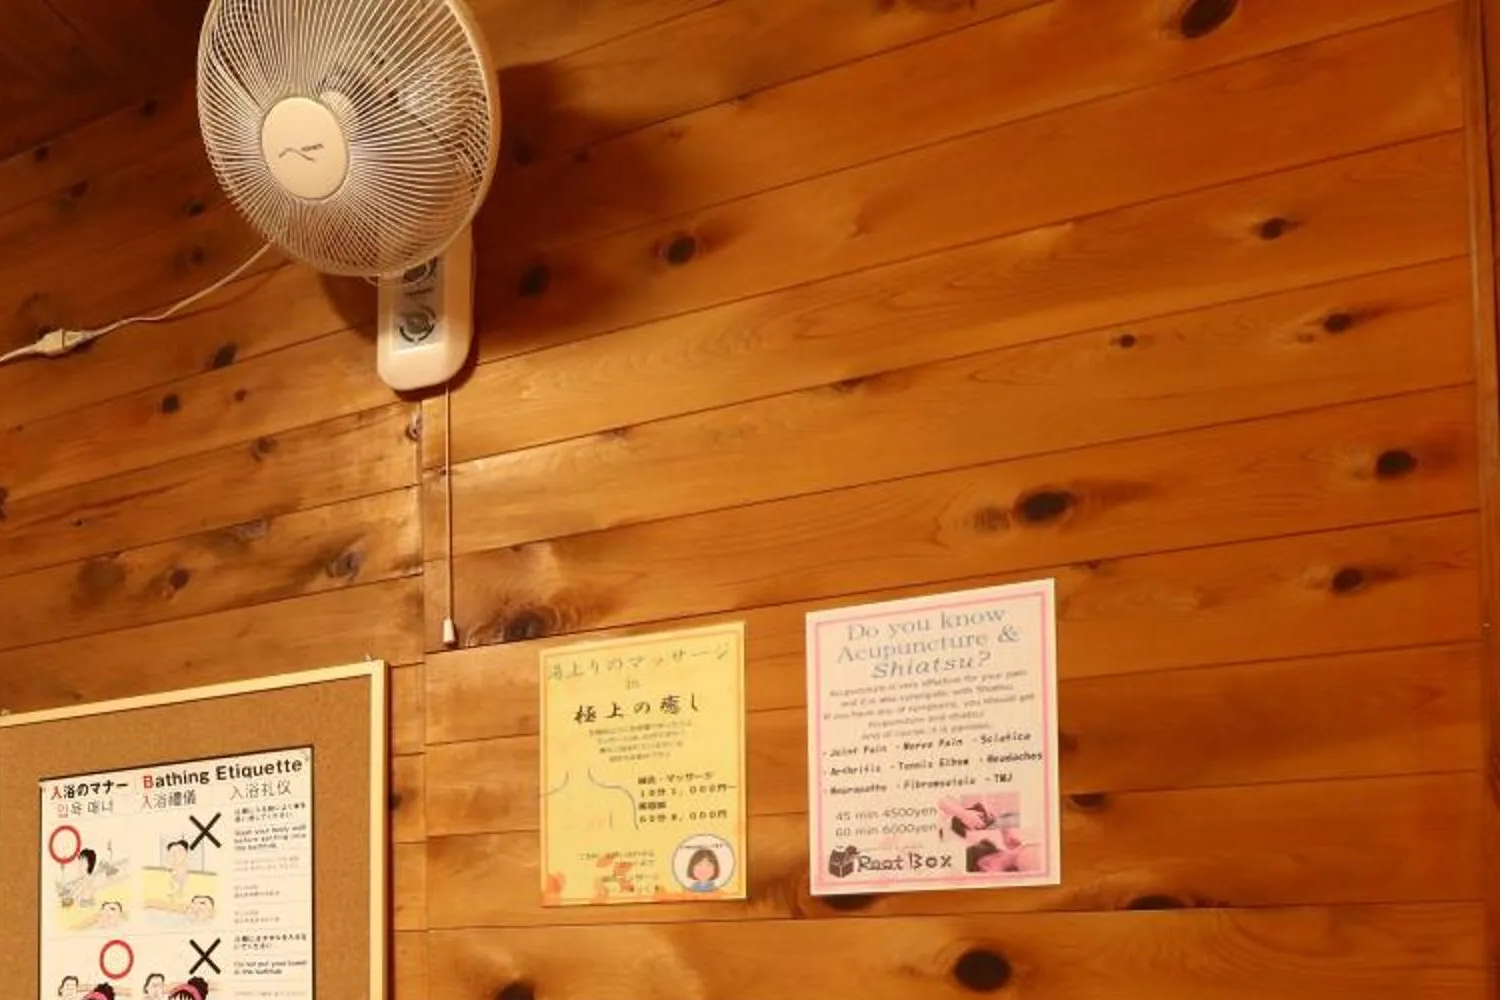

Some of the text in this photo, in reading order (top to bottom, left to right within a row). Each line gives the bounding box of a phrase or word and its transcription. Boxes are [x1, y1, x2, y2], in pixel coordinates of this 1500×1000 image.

[847, 609, 1006, 641] Do you know
[837, 624, 1020, 664] Acupuncture &
[872, 651, 991, 679] Shiatsu?
[143, 758, 303, 789] Bathing Etiquette
[50, 779, 129, 801] 入浴のマナー
[230, 779, 292, 801] 入浴礼仪
[908, 851, 953, 871] Box
